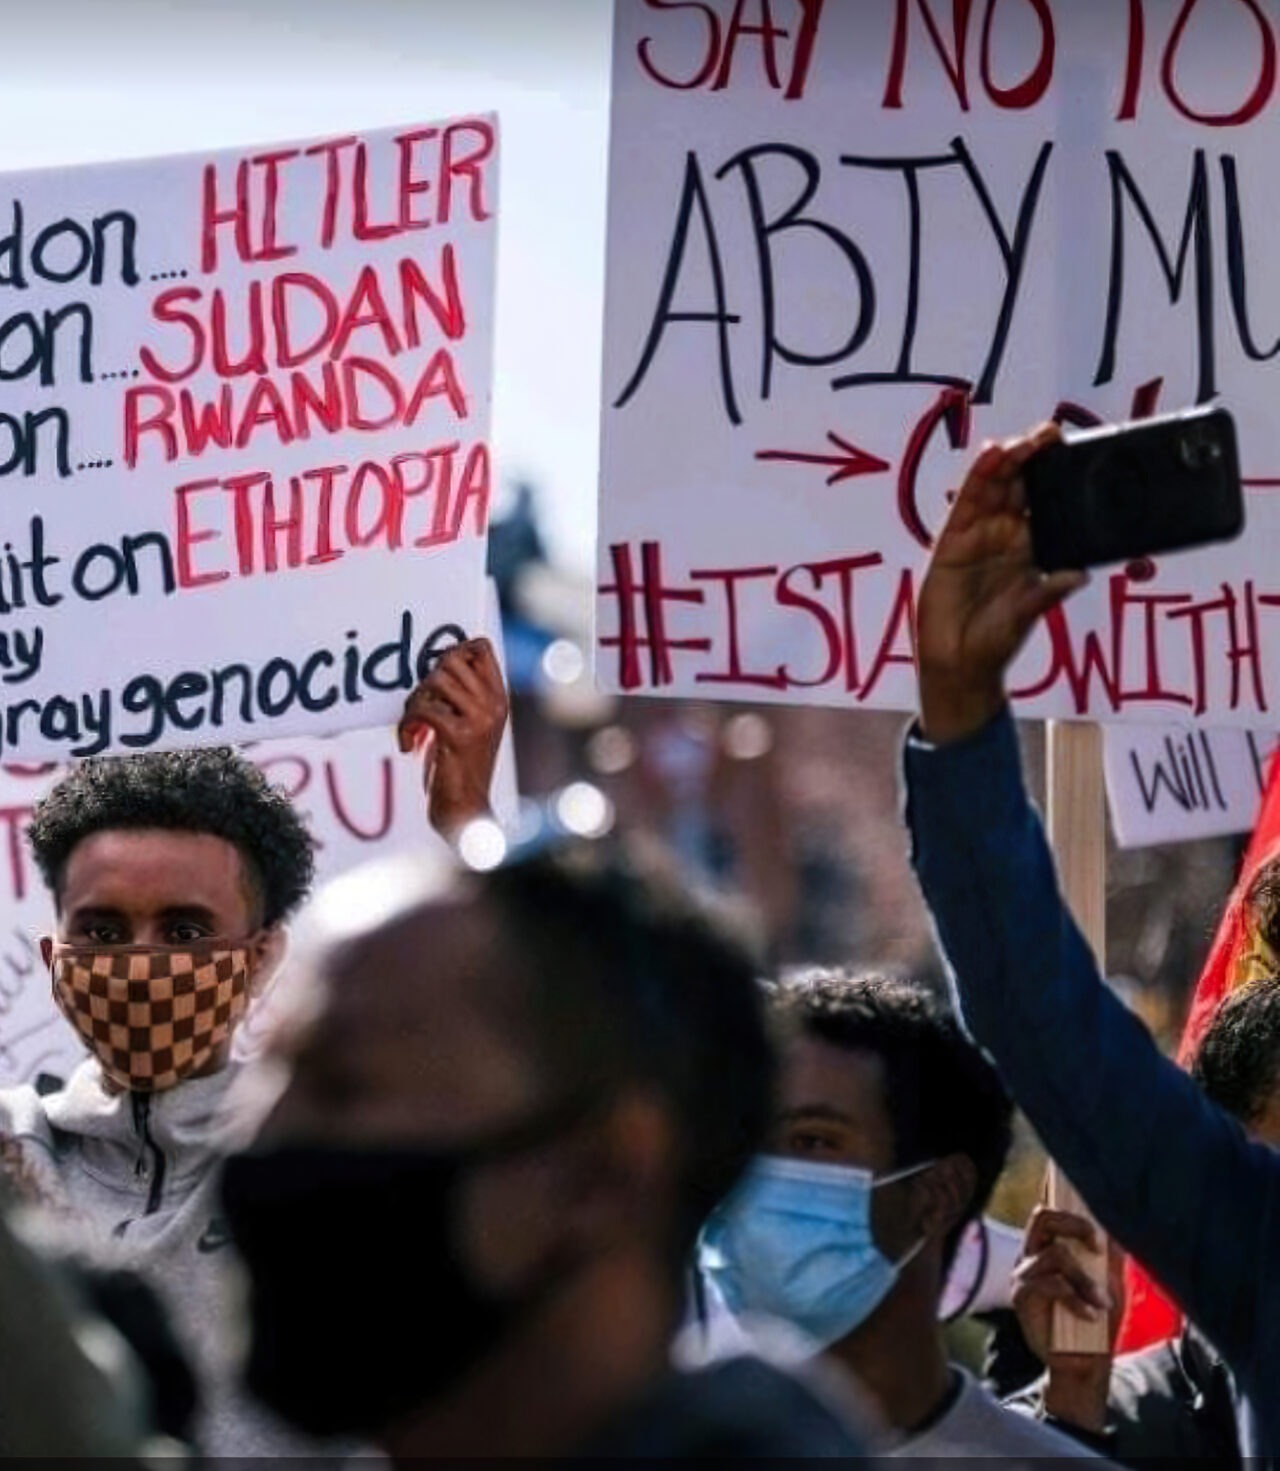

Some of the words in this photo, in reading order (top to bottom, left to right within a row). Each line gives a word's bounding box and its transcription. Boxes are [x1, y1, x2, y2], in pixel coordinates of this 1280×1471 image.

[881, 0, 1056, 112] NO
[200, 120, 494, 274] HITLER
[139, 243, 465, 382] SUDAN
[614, 136, 1053, 426] ABIY
[124, 348, 468, 470] RWANDA
[175, 441, 491, 591] ETHIOPIA
[1130, 729, 1227, 814] Will
